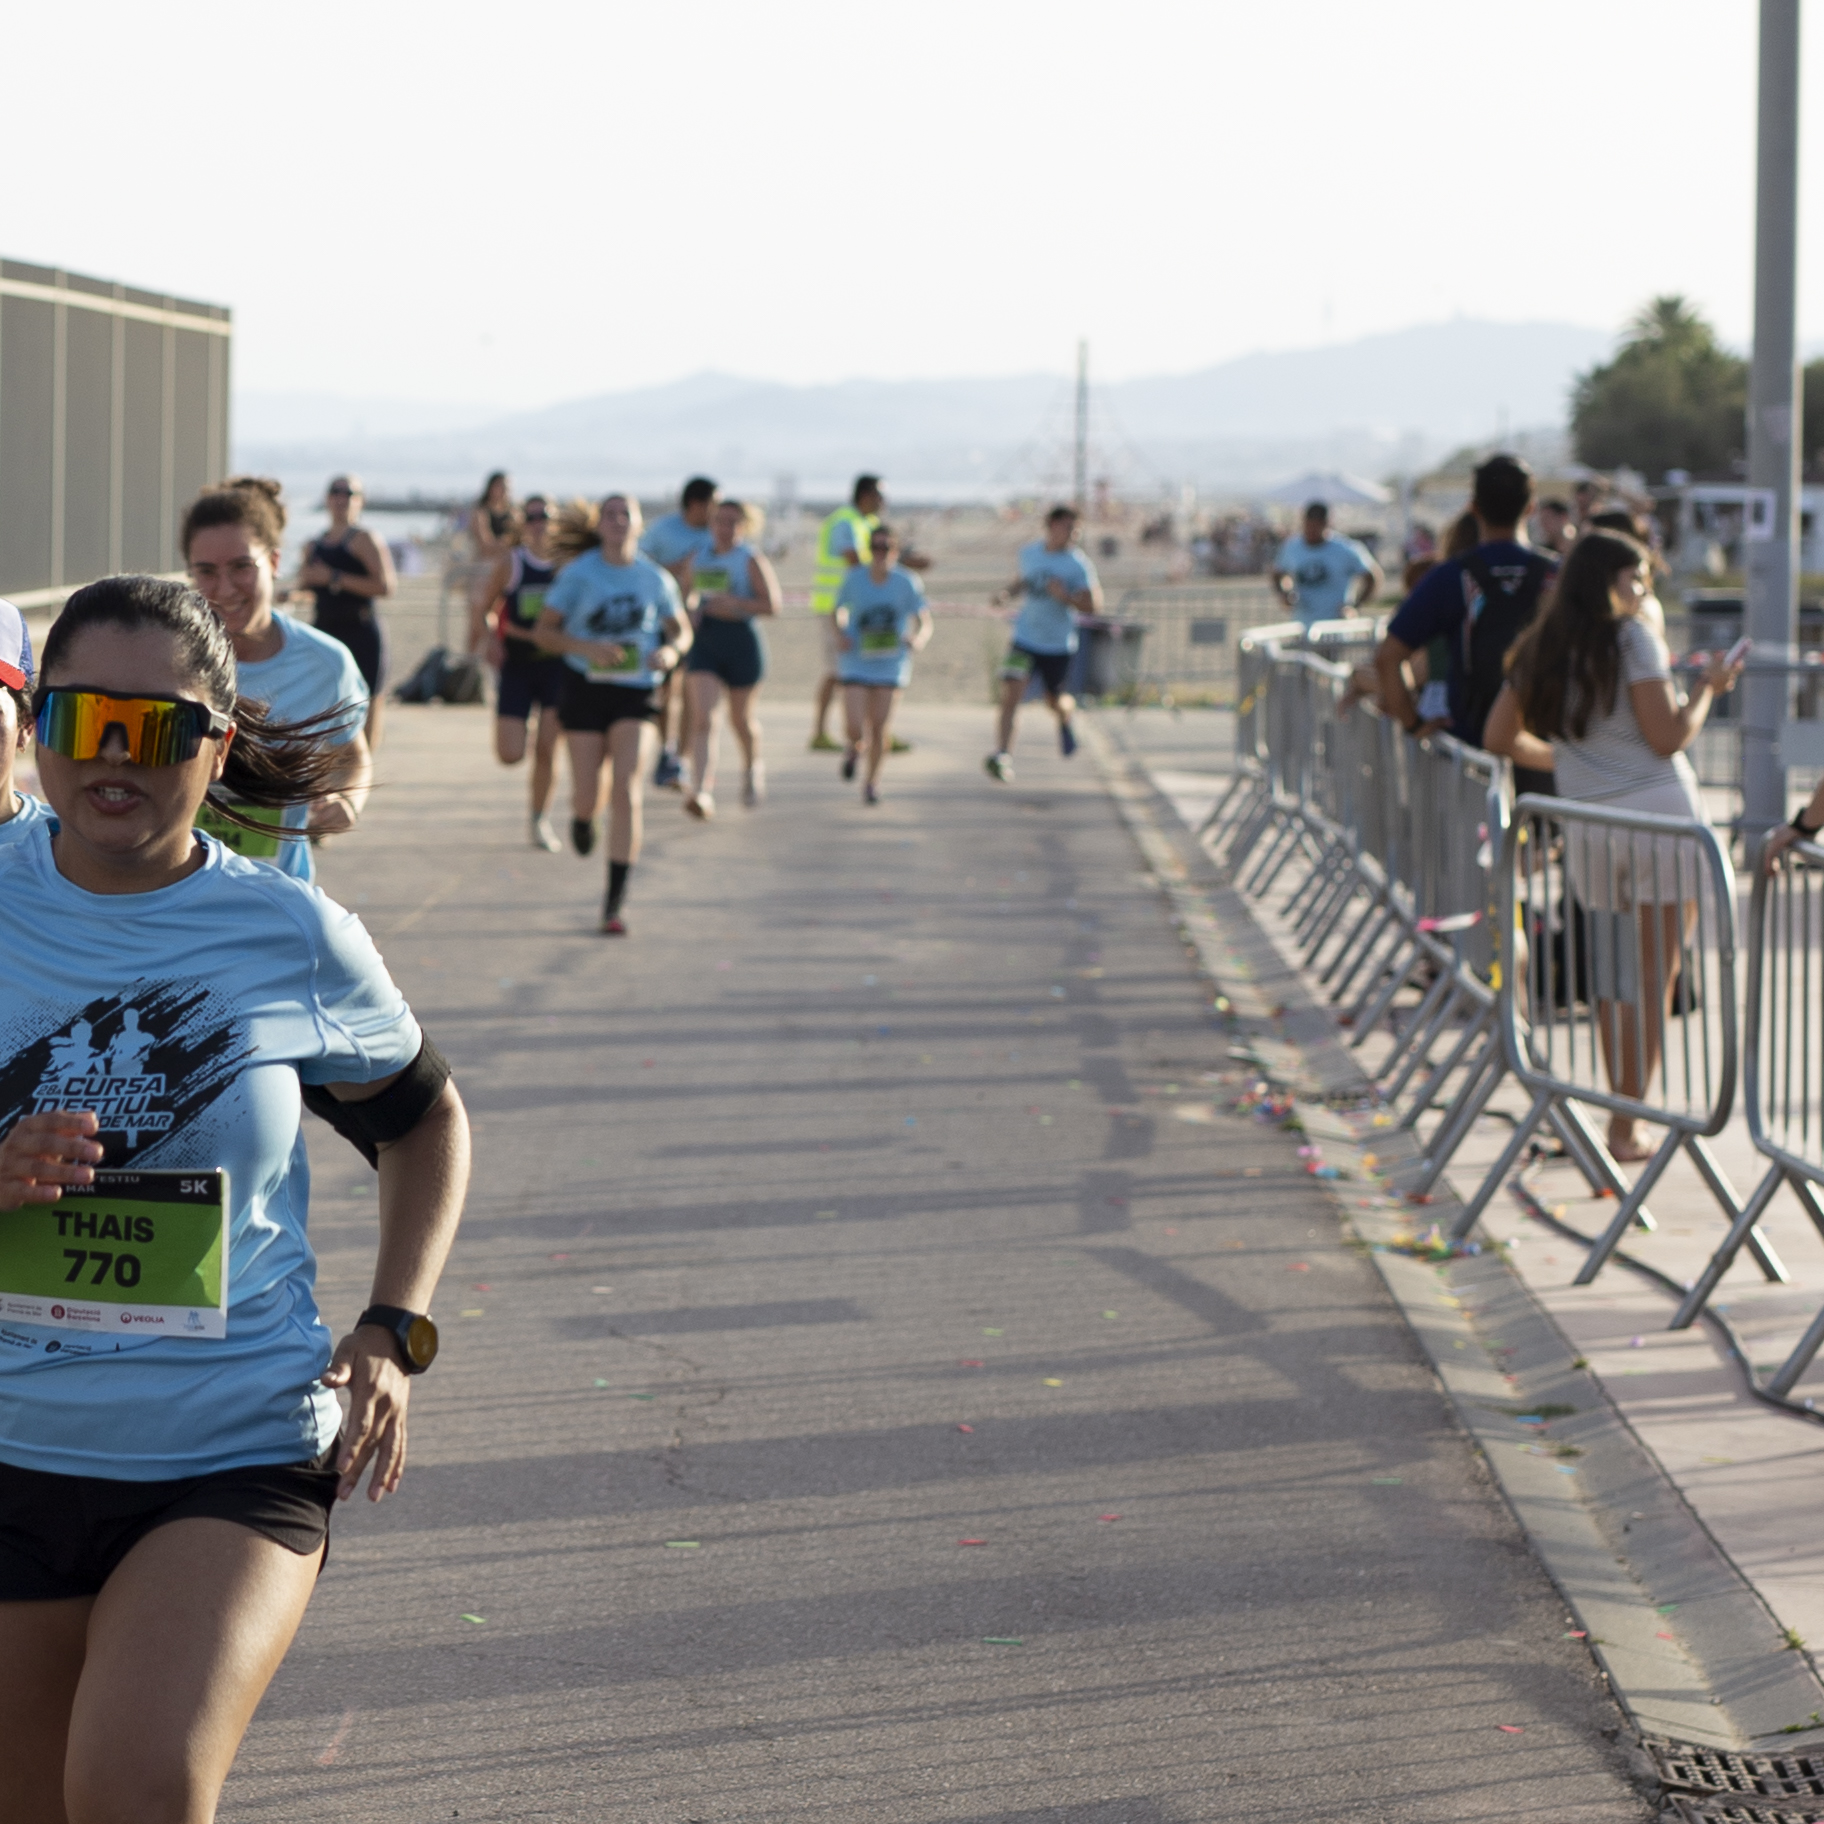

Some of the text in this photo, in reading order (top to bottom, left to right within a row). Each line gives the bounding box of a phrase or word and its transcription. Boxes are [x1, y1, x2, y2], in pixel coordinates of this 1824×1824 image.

[63, 1076, 162, 1097] CURSA
[125, 1115, 171, 1128] MAR
[65, 1185, 96, 1193] MAR
[180, 1179, 208, 1194] 5K
[52, 1210, 154, 1243] THAIS
[63, 1248, 141, 1288] 770
[133, 1315, 165, 1324] VEOLIA
